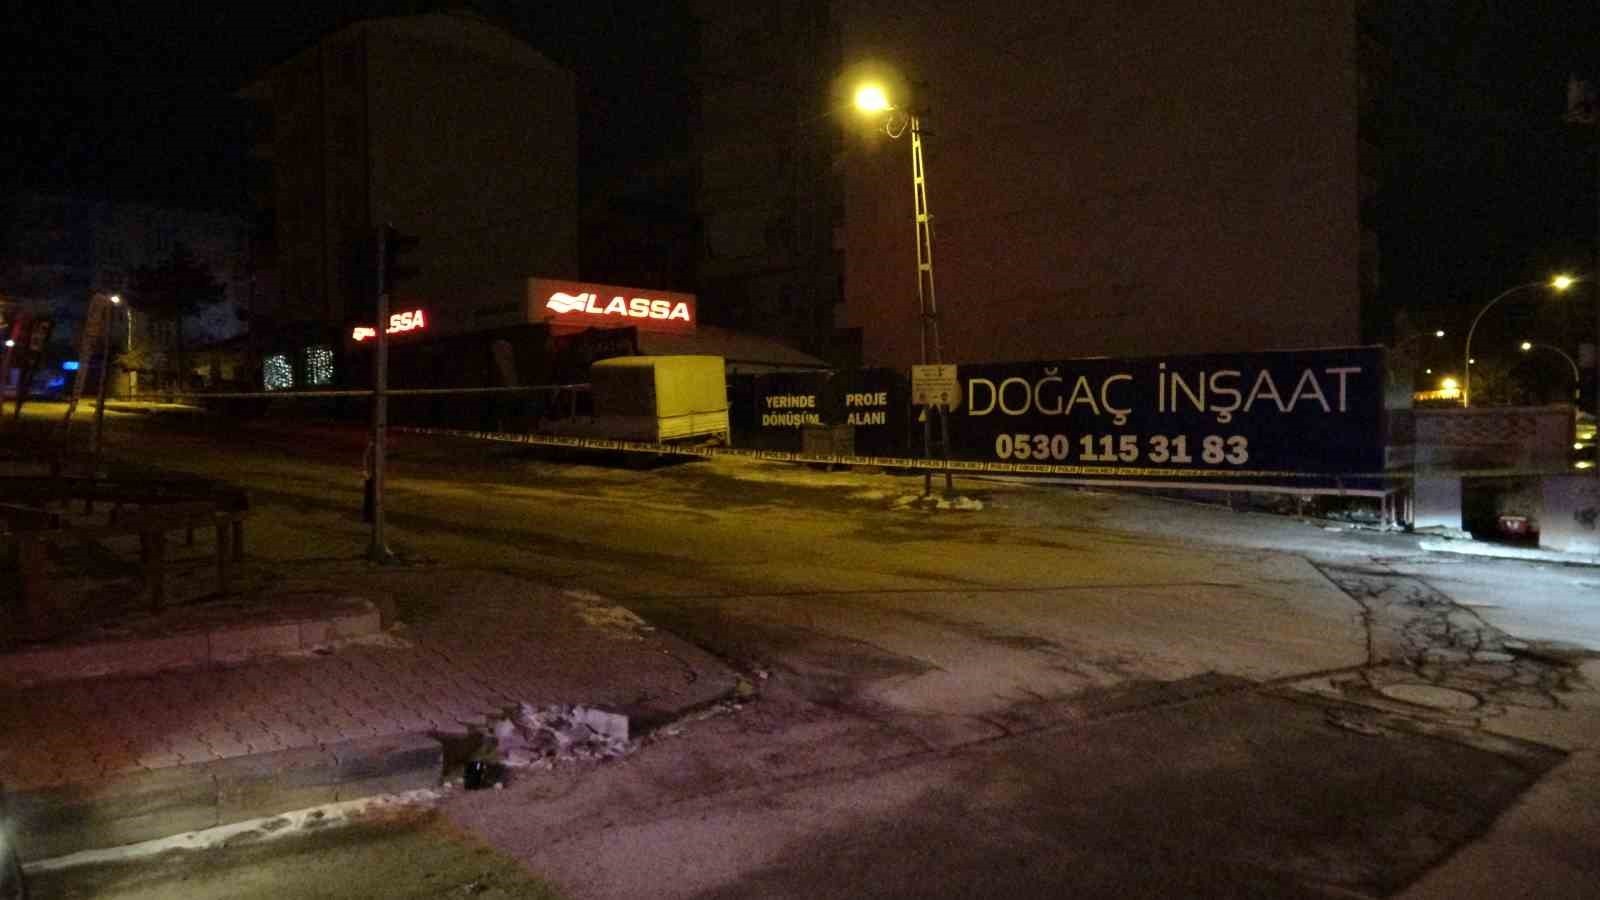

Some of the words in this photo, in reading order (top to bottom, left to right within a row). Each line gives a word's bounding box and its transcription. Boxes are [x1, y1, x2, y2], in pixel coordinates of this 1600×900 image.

[585, 293, 690, 321] LASSA
[765, 393, 816, 408] YERİNDE
[845, 392, 887, 407] PROJE
[968, 365, 1133, 426] DOĞAÇ
[1158, 362, 1362, 424] İNŞAAT
[847, 411, 886, 425] ALANI
[995, 434, 1070, 460] 0530
[1079, 434, 1139, 462] 115
[1149, 434, 1193, 463] 31
[1201, 434, 1249, 465] 83
